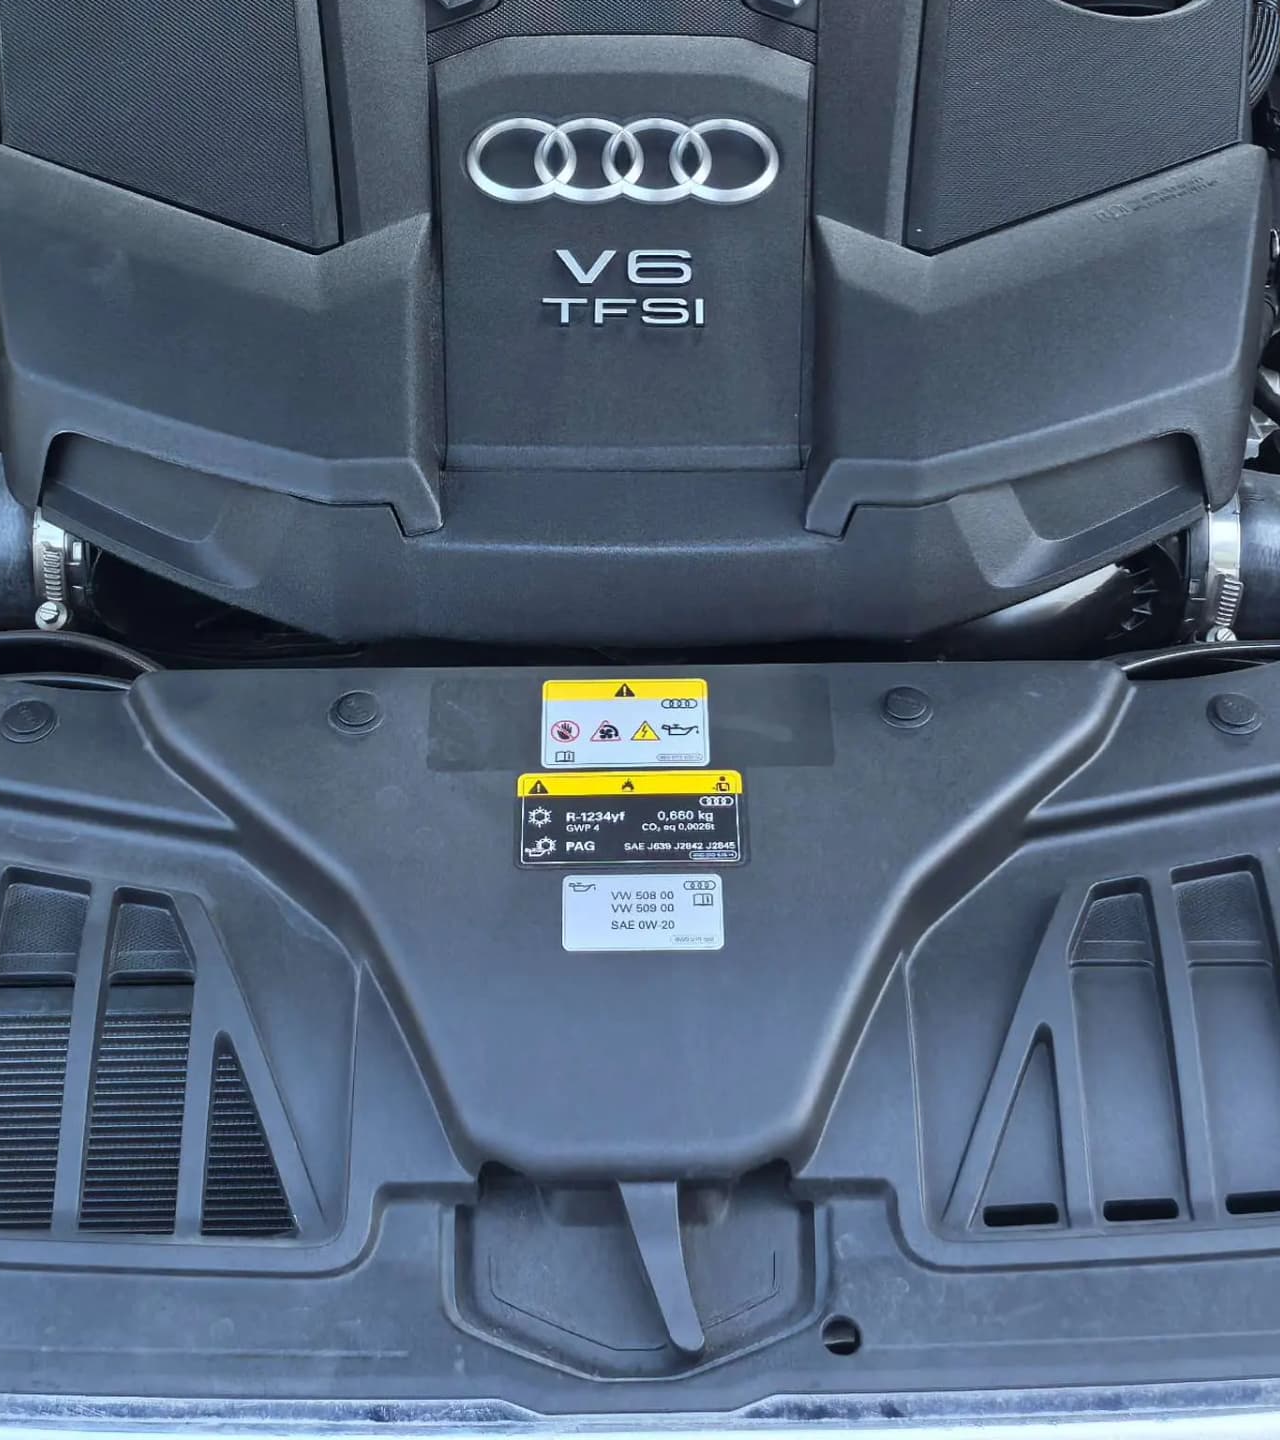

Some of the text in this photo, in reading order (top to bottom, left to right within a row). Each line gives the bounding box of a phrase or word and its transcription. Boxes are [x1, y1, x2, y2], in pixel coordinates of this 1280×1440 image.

[555, 249, 693, 285] V6
[541, 297, 706, 325] TFSI
[566, 811, 626, 823] R-1234yf
[698, 810, 714, 822] kg
[566, 824, 591, 832] GWP
[593, 824, 600, 832] 4
[566, 841, 596, 851] PAG
[624, 842, 645, 851] SAE
[611, 890, 674, 900] VW 508 00
[611, 903, 675, 913] VW 509 00
[611, 920, 676, 930] SAE 0W-20
